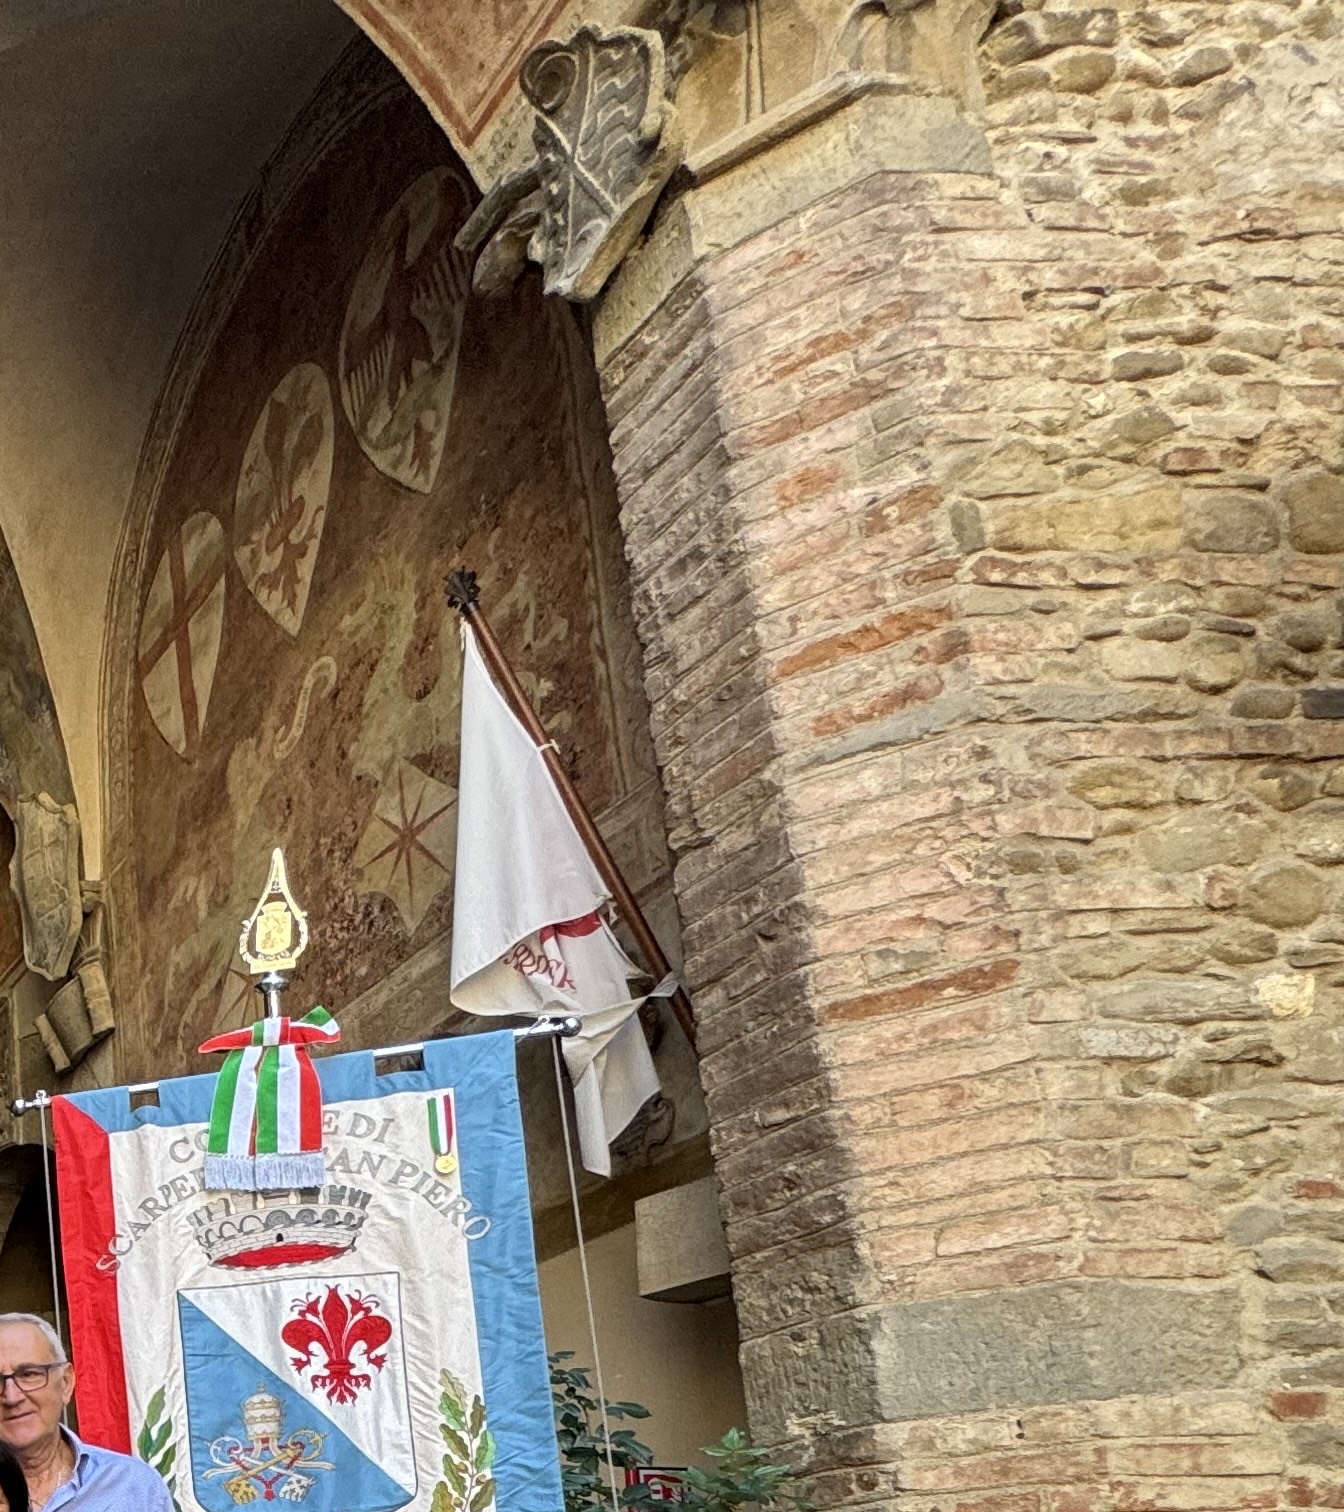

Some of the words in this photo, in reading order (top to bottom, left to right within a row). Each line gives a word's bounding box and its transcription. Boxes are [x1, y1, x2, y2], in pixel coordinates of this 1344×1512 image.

[346, 1112, 395, 1144] DI
[95, 1167, 205, 1276] SCARPE
[324, 1146, 389, 1180] AN
[387, 1158, 492, 1240] PIERO
